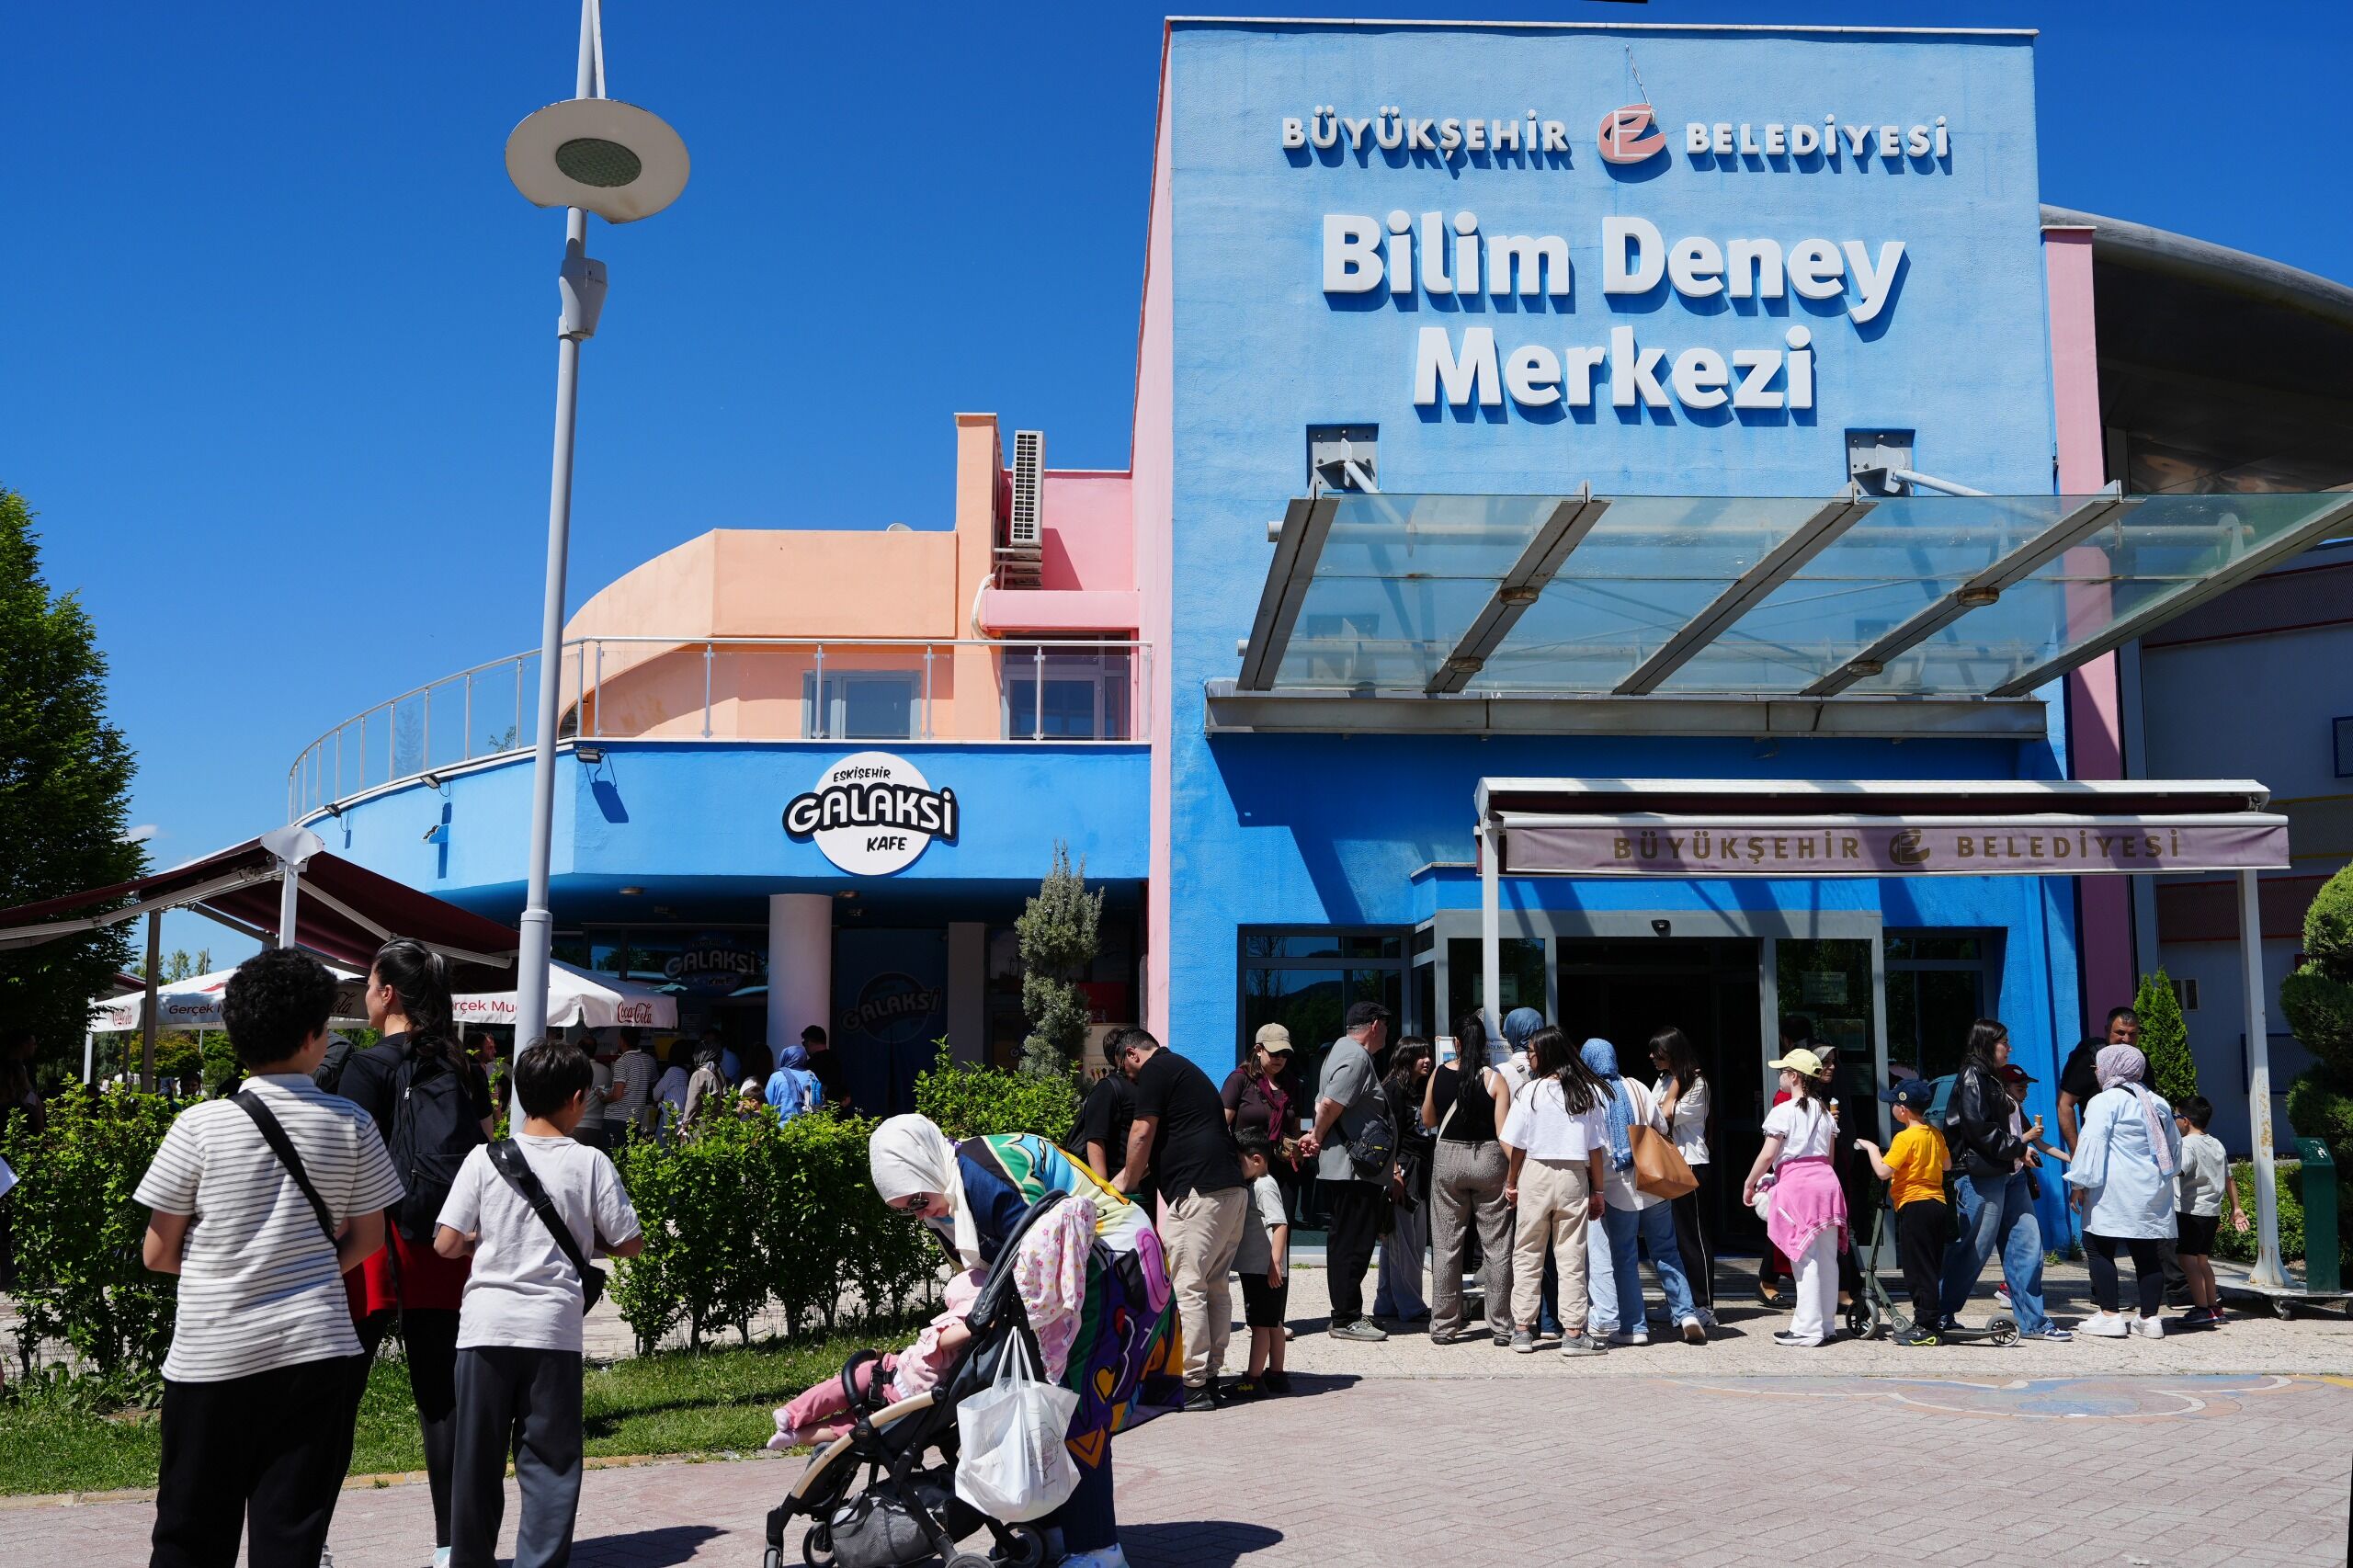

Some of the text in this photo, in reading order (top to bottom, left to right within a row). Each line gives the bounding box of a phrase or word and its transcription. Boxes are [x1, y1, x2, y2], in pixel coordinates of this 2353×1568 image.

[1282, 105, 1948, 161] BÜYÜKŞEHİR BELEDİYESİ
[1323, 210, 1905, 324] Bilim Deney
[1414, 324, 1813, 409] Merkezi
[834, 766, 891, 782] ESKİŞEHİR
[788, 789, 952, 836] GALAKSİ
[867, 836, 907, 852] KAFE
[1613, 829, 2178, 864] BÜYÜKŞEHİR BELEDİYESİ
[168, 1004, 214, 1017] Gerçek
